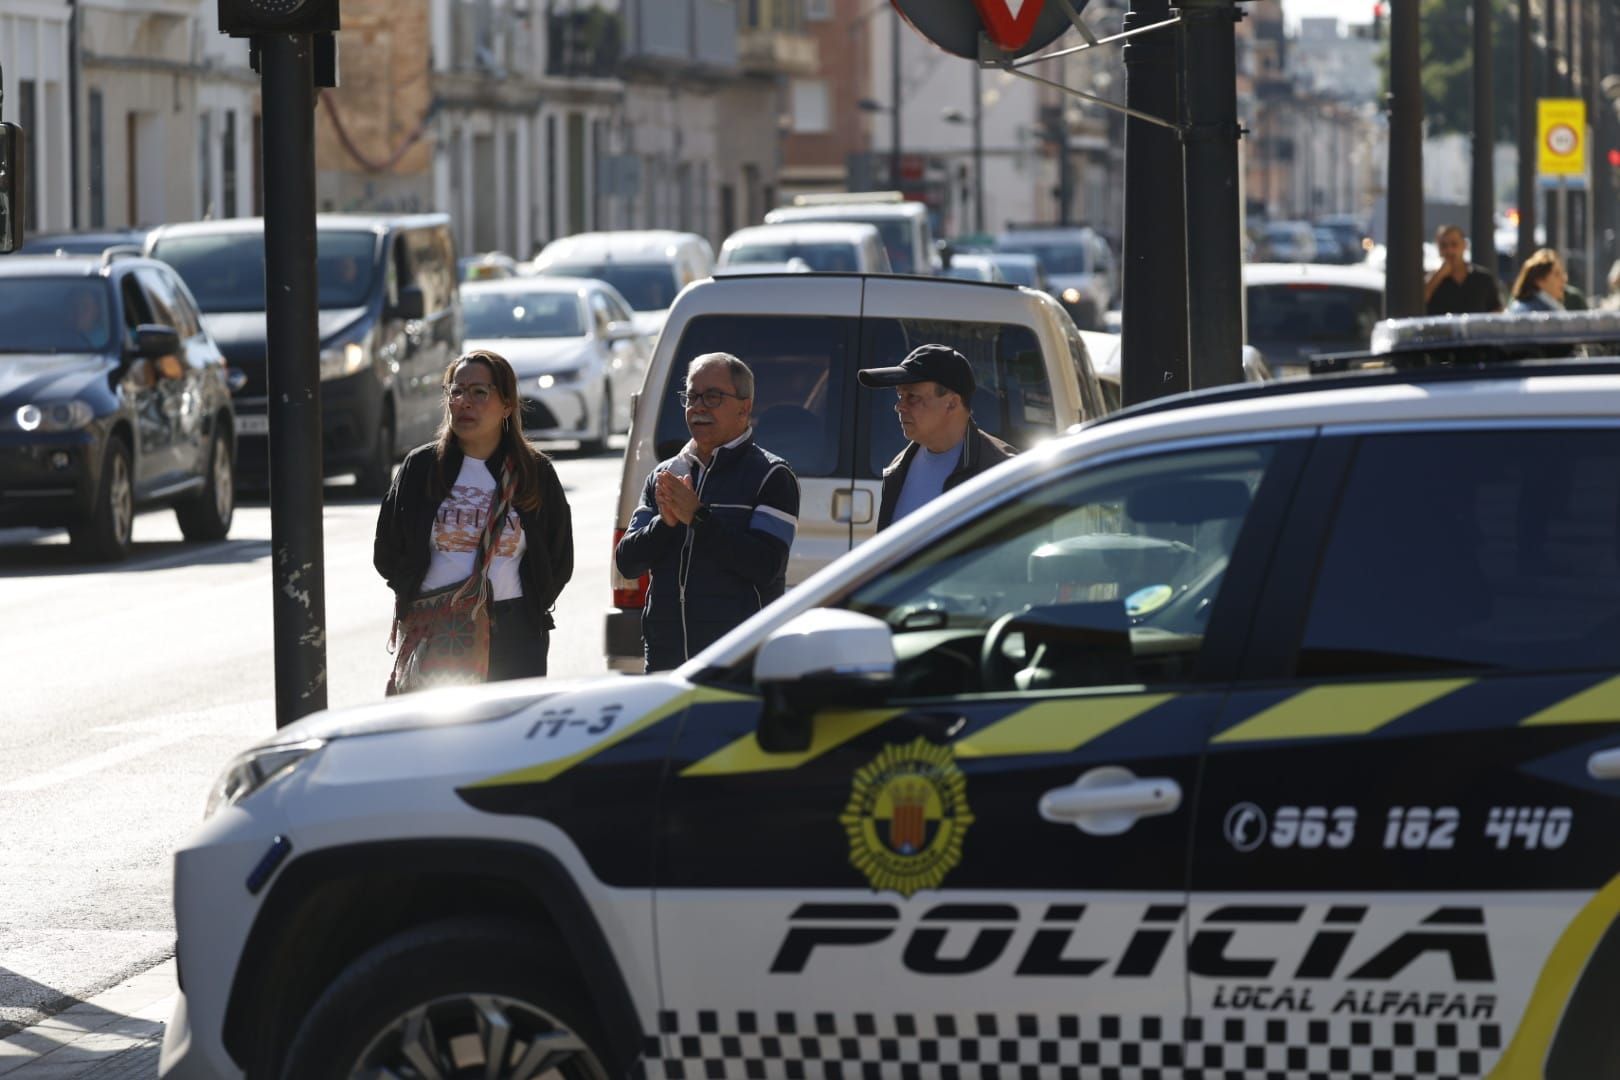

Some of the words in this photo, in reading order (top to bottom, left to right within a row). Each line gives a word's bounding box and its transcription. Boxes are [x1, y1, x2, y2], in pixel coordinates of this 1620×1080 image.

[1271, 806, 1358, 848] 963
[1383, 807, 1460, 849] 182
[1485, 807, 1573, 849] 440
[768, 902, 1496, 983] POLICIA
[1212, 985, 1315, 1012] LOCAL
[1332, 989, 1497, 1020] ALFAFAR
